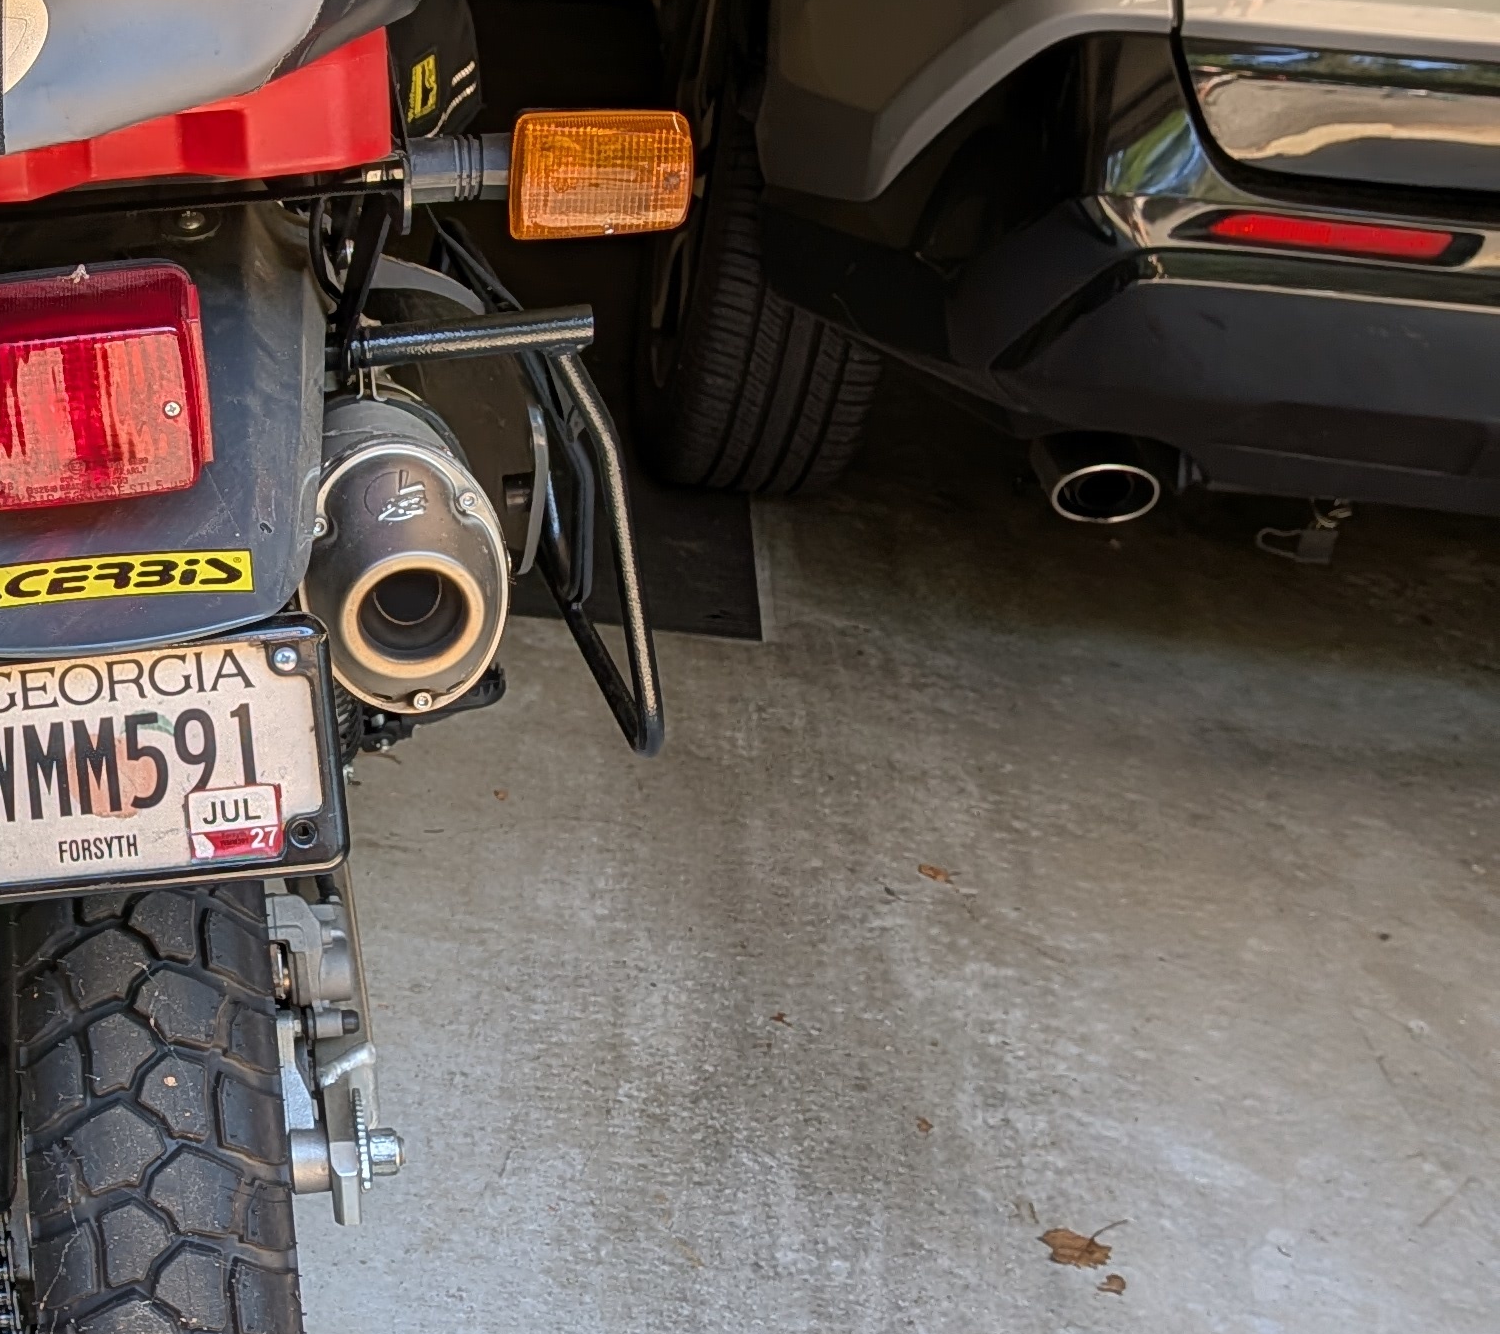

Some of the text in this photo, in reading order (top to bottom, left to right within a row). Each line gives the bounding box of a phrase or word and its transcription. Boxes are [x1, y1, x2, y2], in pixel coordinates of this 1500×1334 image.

[202, 797, 262, 825] JUL
[58, 833, 139, 864] FORSYTH
[250, 827, 279, 849] 27
